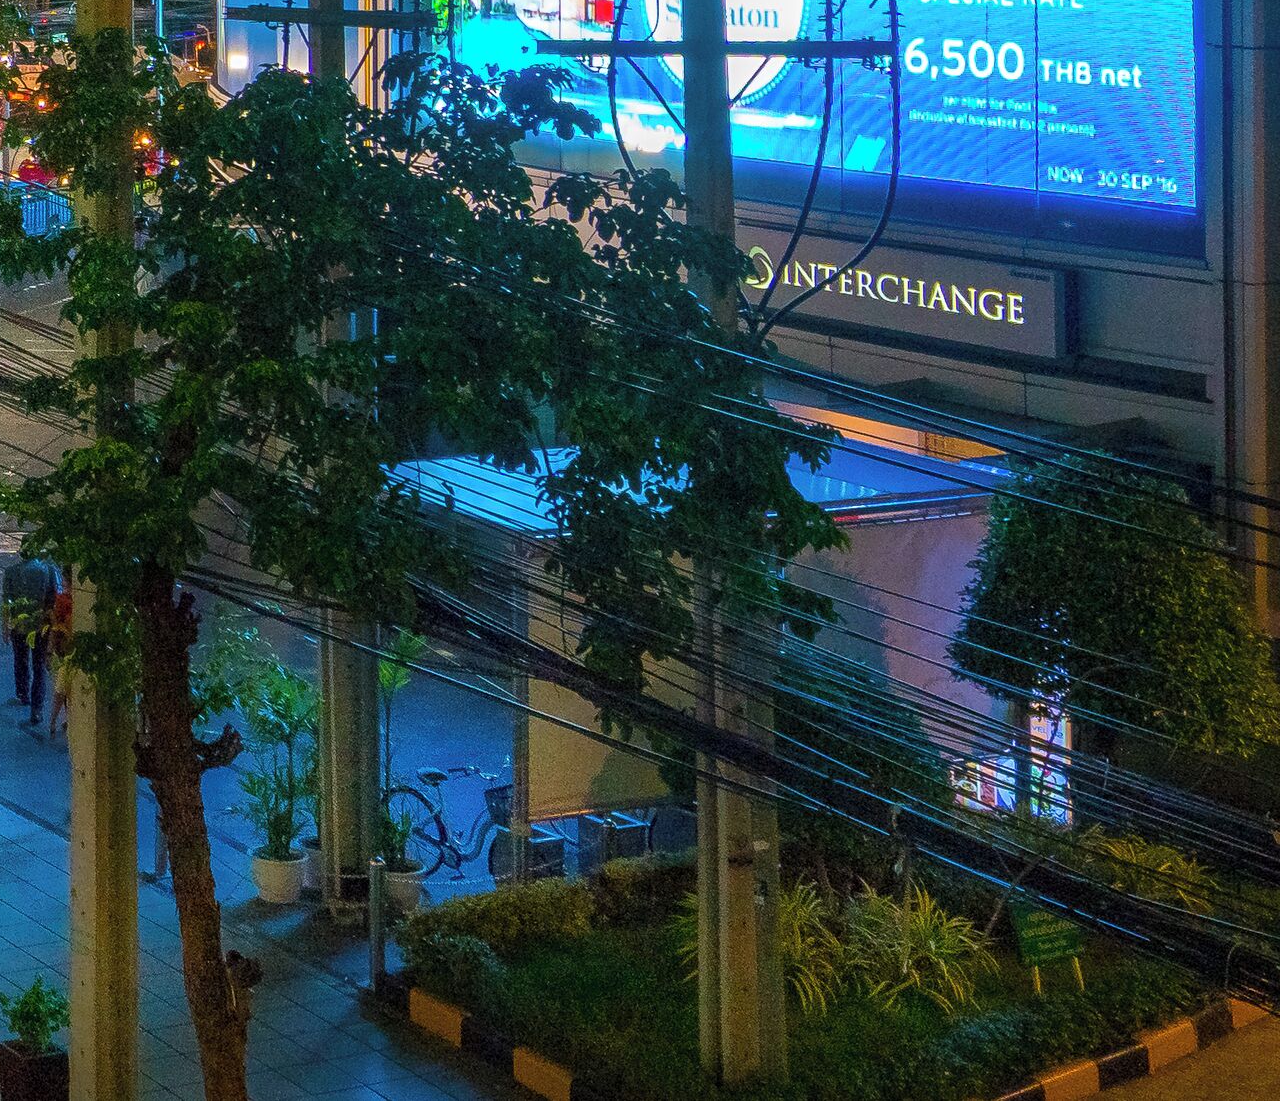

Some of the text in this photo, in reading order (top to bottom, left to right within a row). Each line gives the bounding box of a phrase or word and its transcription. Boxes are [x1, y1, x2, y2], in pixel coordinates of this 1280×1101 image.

[904, 37, 1143, 88] 6,500 THB net
[1047, 166, 1086, 184] NOW
[1121, 172, 1153, 191] SEP
[781, 259, 1025, 325] INTERCHANGE
